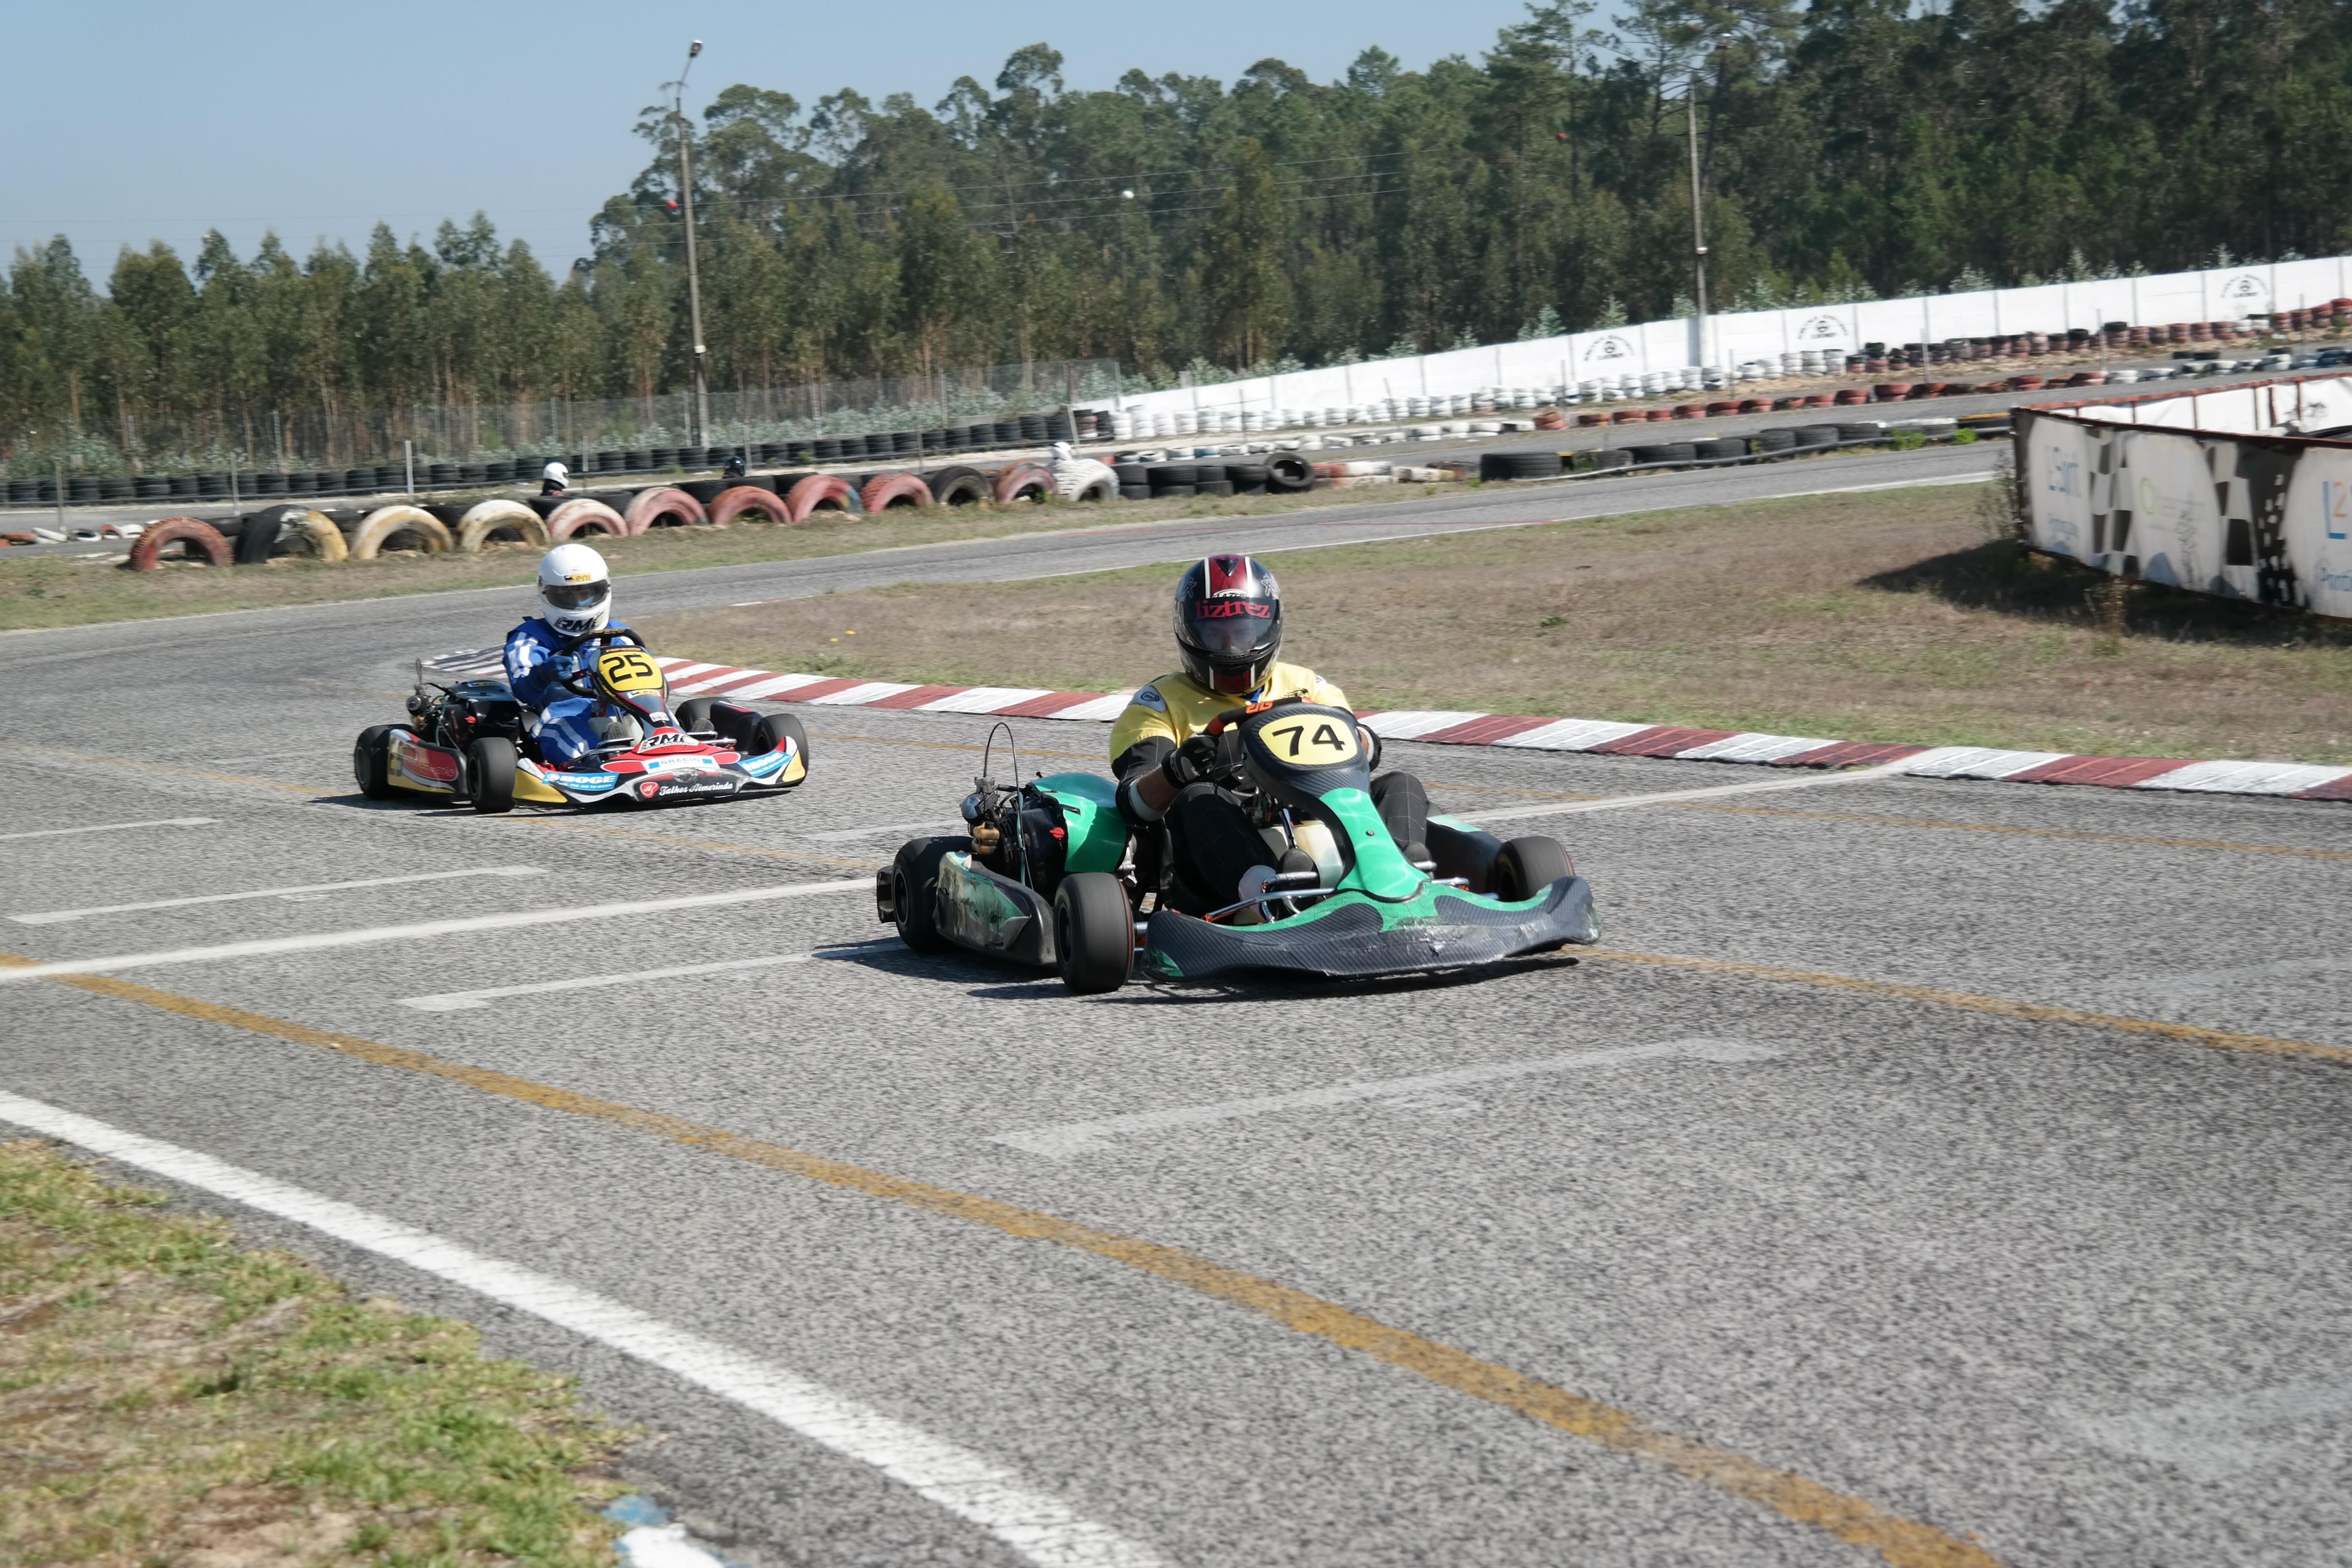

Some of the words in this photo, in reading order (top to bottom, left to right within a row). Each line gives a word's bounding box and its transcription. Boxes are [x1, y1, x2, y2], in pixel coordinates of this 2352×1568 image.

[1194, 599, 1271, 620] liztrez
[602, 653, 653, 684] 25
[1271, 724, 1346, 756] 74
[560, 775, 616, 783] BOGE
[659, 785, 688, 796] Talhos
